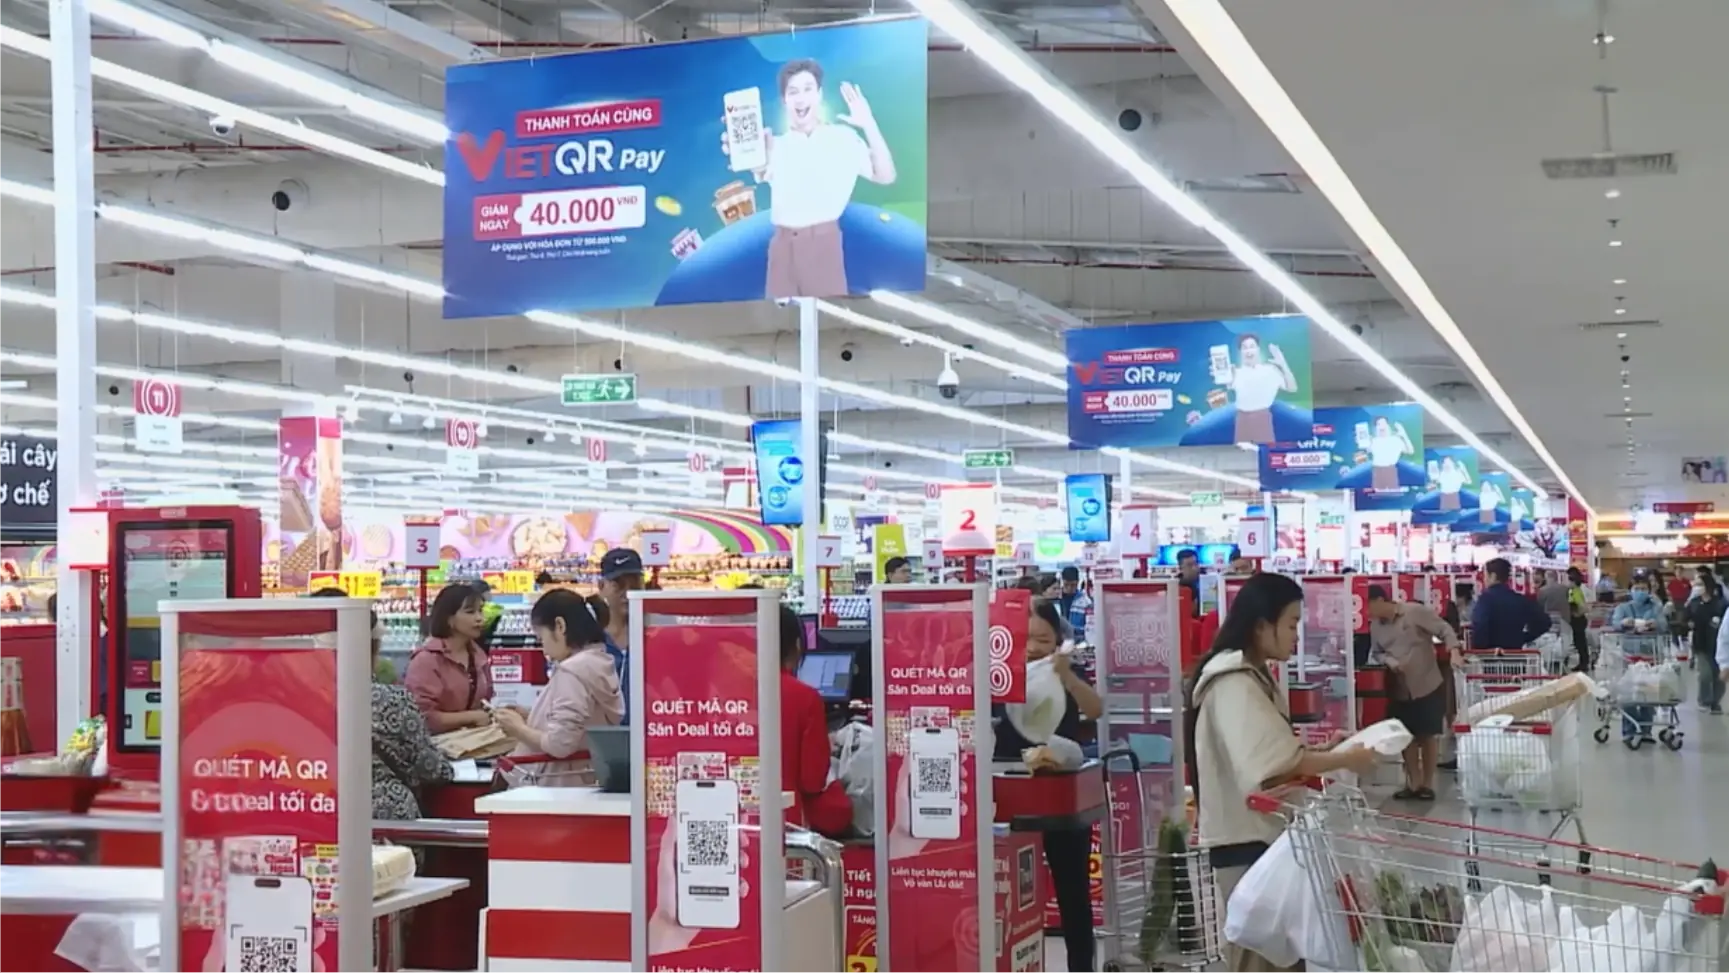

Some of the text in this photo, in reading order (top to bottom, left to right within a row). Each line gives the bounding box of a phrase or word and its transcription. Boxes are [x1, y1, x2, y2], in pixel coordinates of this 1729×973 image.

[525, 106, 653, 131] THANH TOÁN CÙNG
[620, 148, 665, 174] Pay
[529, 197, 615, 226] 40.000
[480, 219, 510, 232] NGAY
[1158, 371, 1182, 384] Pay
[152, 390, 164, 408] 11
[1113, 394, 1157, 408] 40.000
[23, 443, 57, 472] cây
[13, 479, 51, 506] chế
[960, 509, 977, 531] 2
[1130, 524, 1141, 540] 4
[1248, 532, 1256, 546] 6
[416, 538, 428, 553] 3
[650, 542, 660, 554] 5
[825, 546, 833, 558] 7
[929, 550, 936, 558] 9
[891, 664, 924, 678] QUÉT
[948, 668, 968, 678] QR
[911, 684, 936, 695] Deal
[956, 684, 972, 695] đa
[652, 696, 748, 714] QUÉT MÃ QR
[648, 720, 754, 736] Săn Deal tối đa
[193, 754, 328, 780] QUÉT MÃ QR
[280, 788, 305, 812] tối
[310, 793, 335, 812] đa
[846, 868, 872, 882] Tiết
[892, 866, 910, 876] Liên
